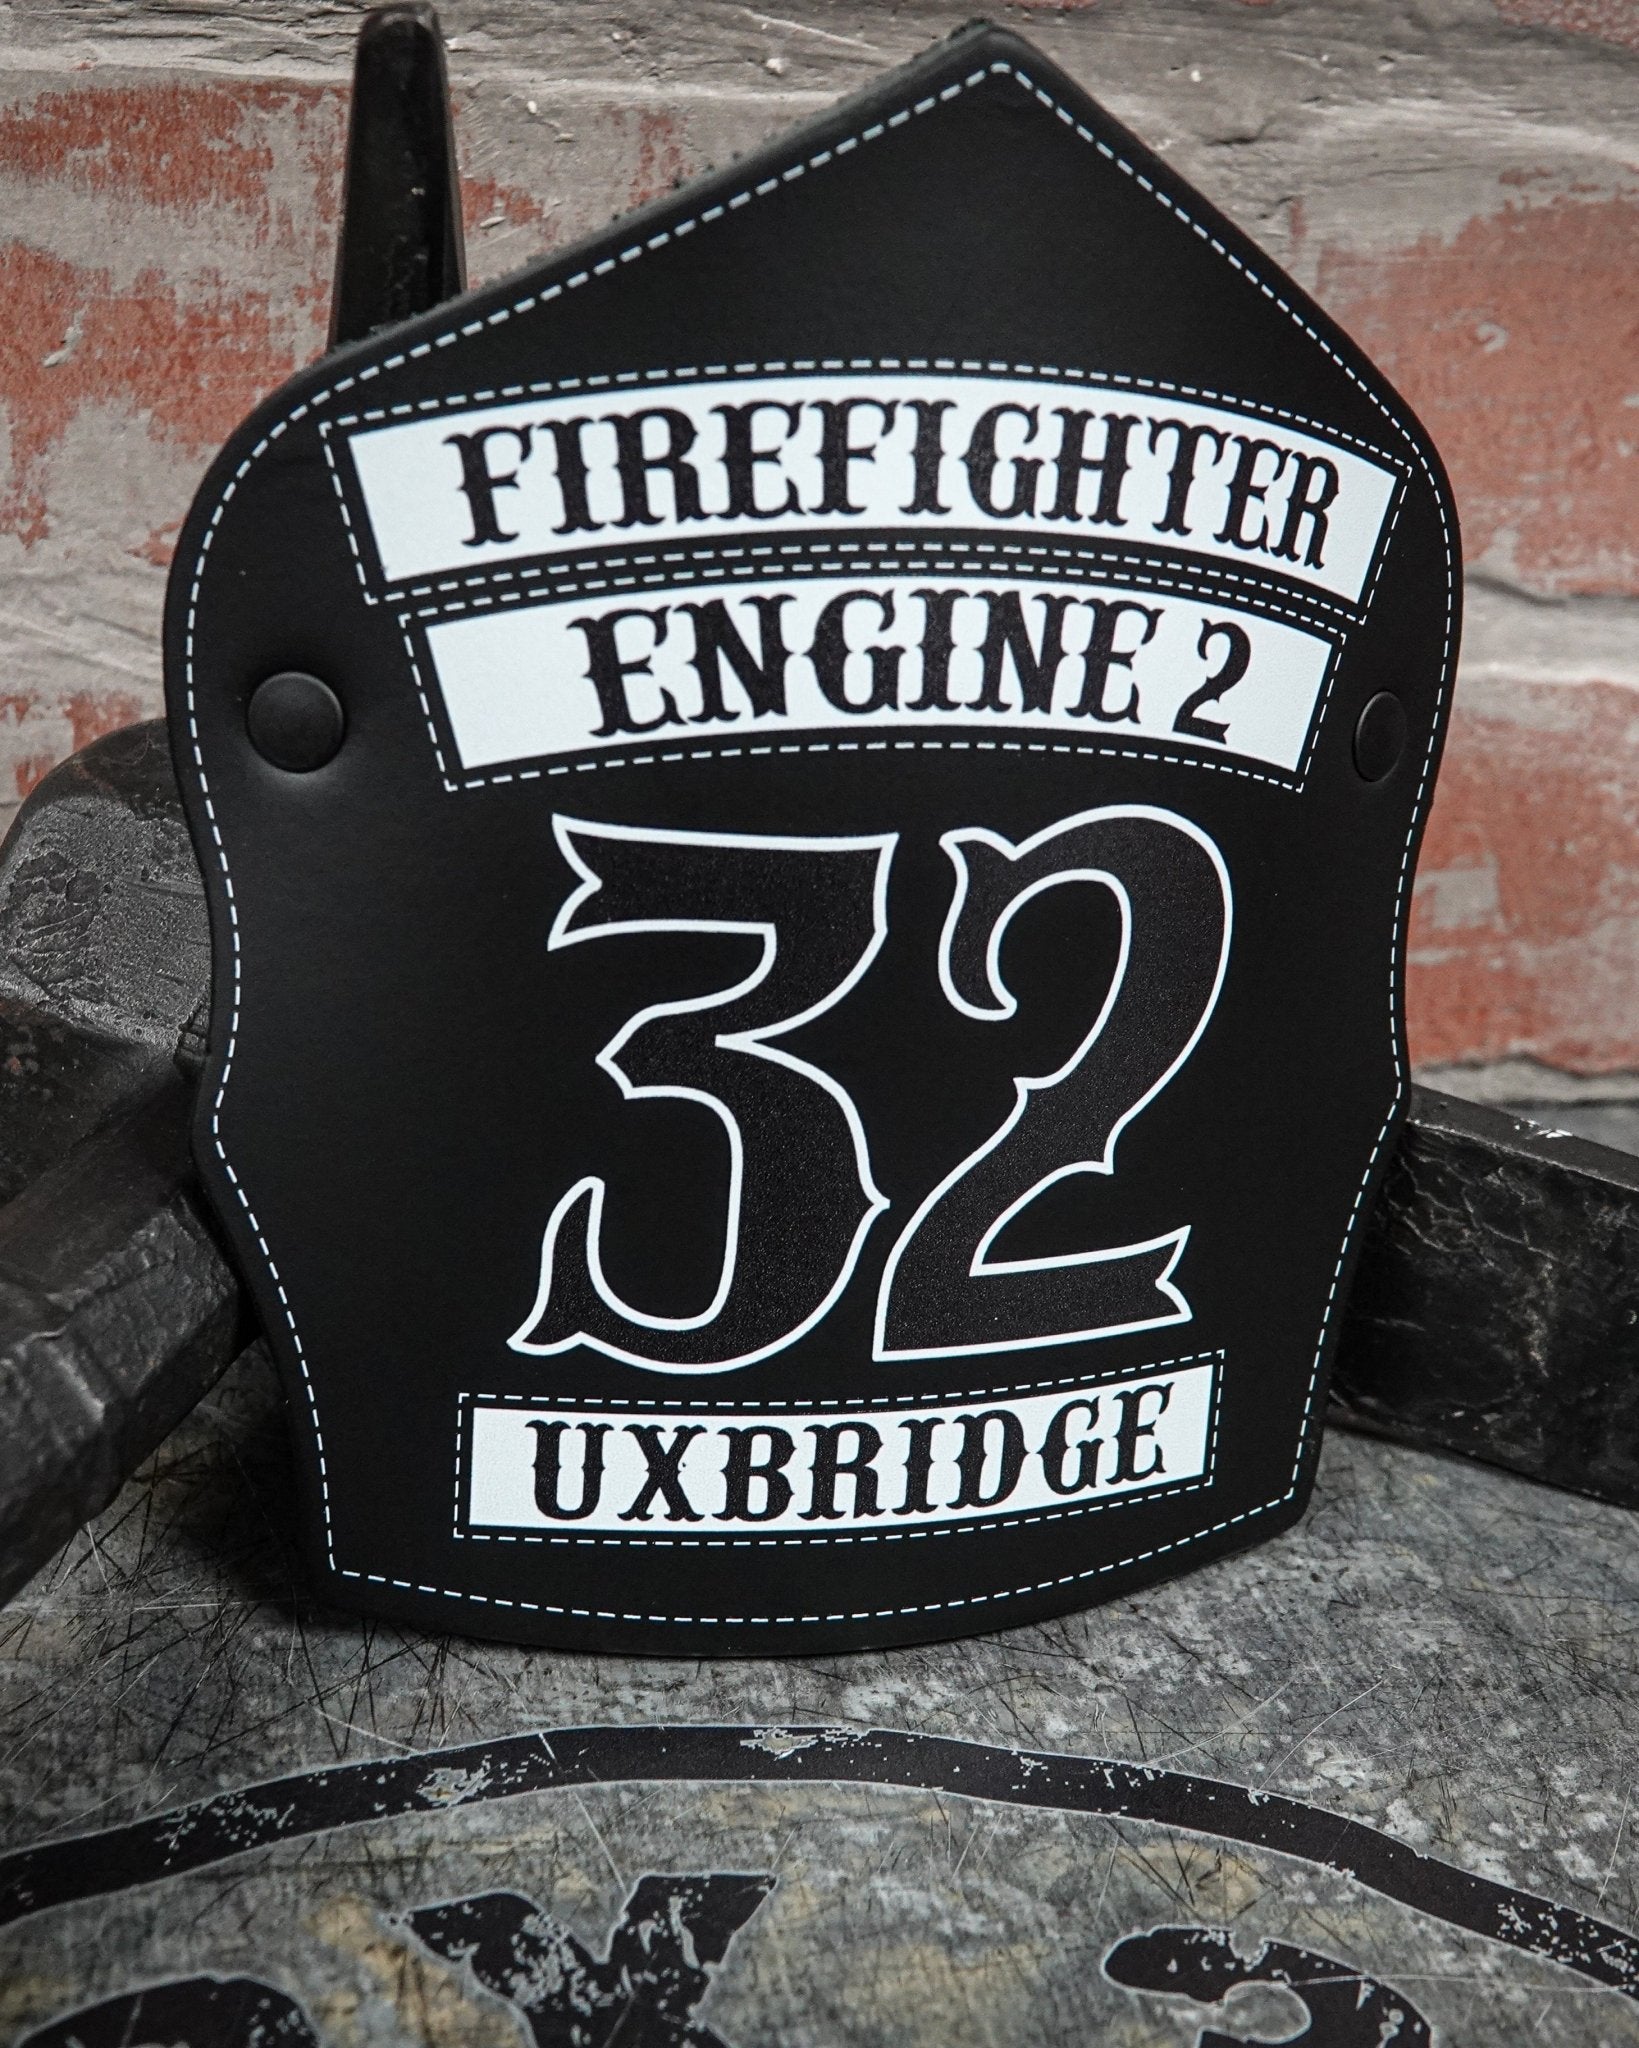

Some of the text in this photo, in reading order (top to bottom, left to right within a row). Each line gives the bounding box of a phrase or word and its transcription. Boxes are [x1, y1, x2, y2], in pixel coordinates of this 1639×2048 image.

[444, 398, 1340, 570] FIREFIGHTER
[568, 587, 1253, 743] ENGINE 2
[507, 804, 1233, 1373] 32
[525, 1382, 1174, 1521] UXBRIDGE
